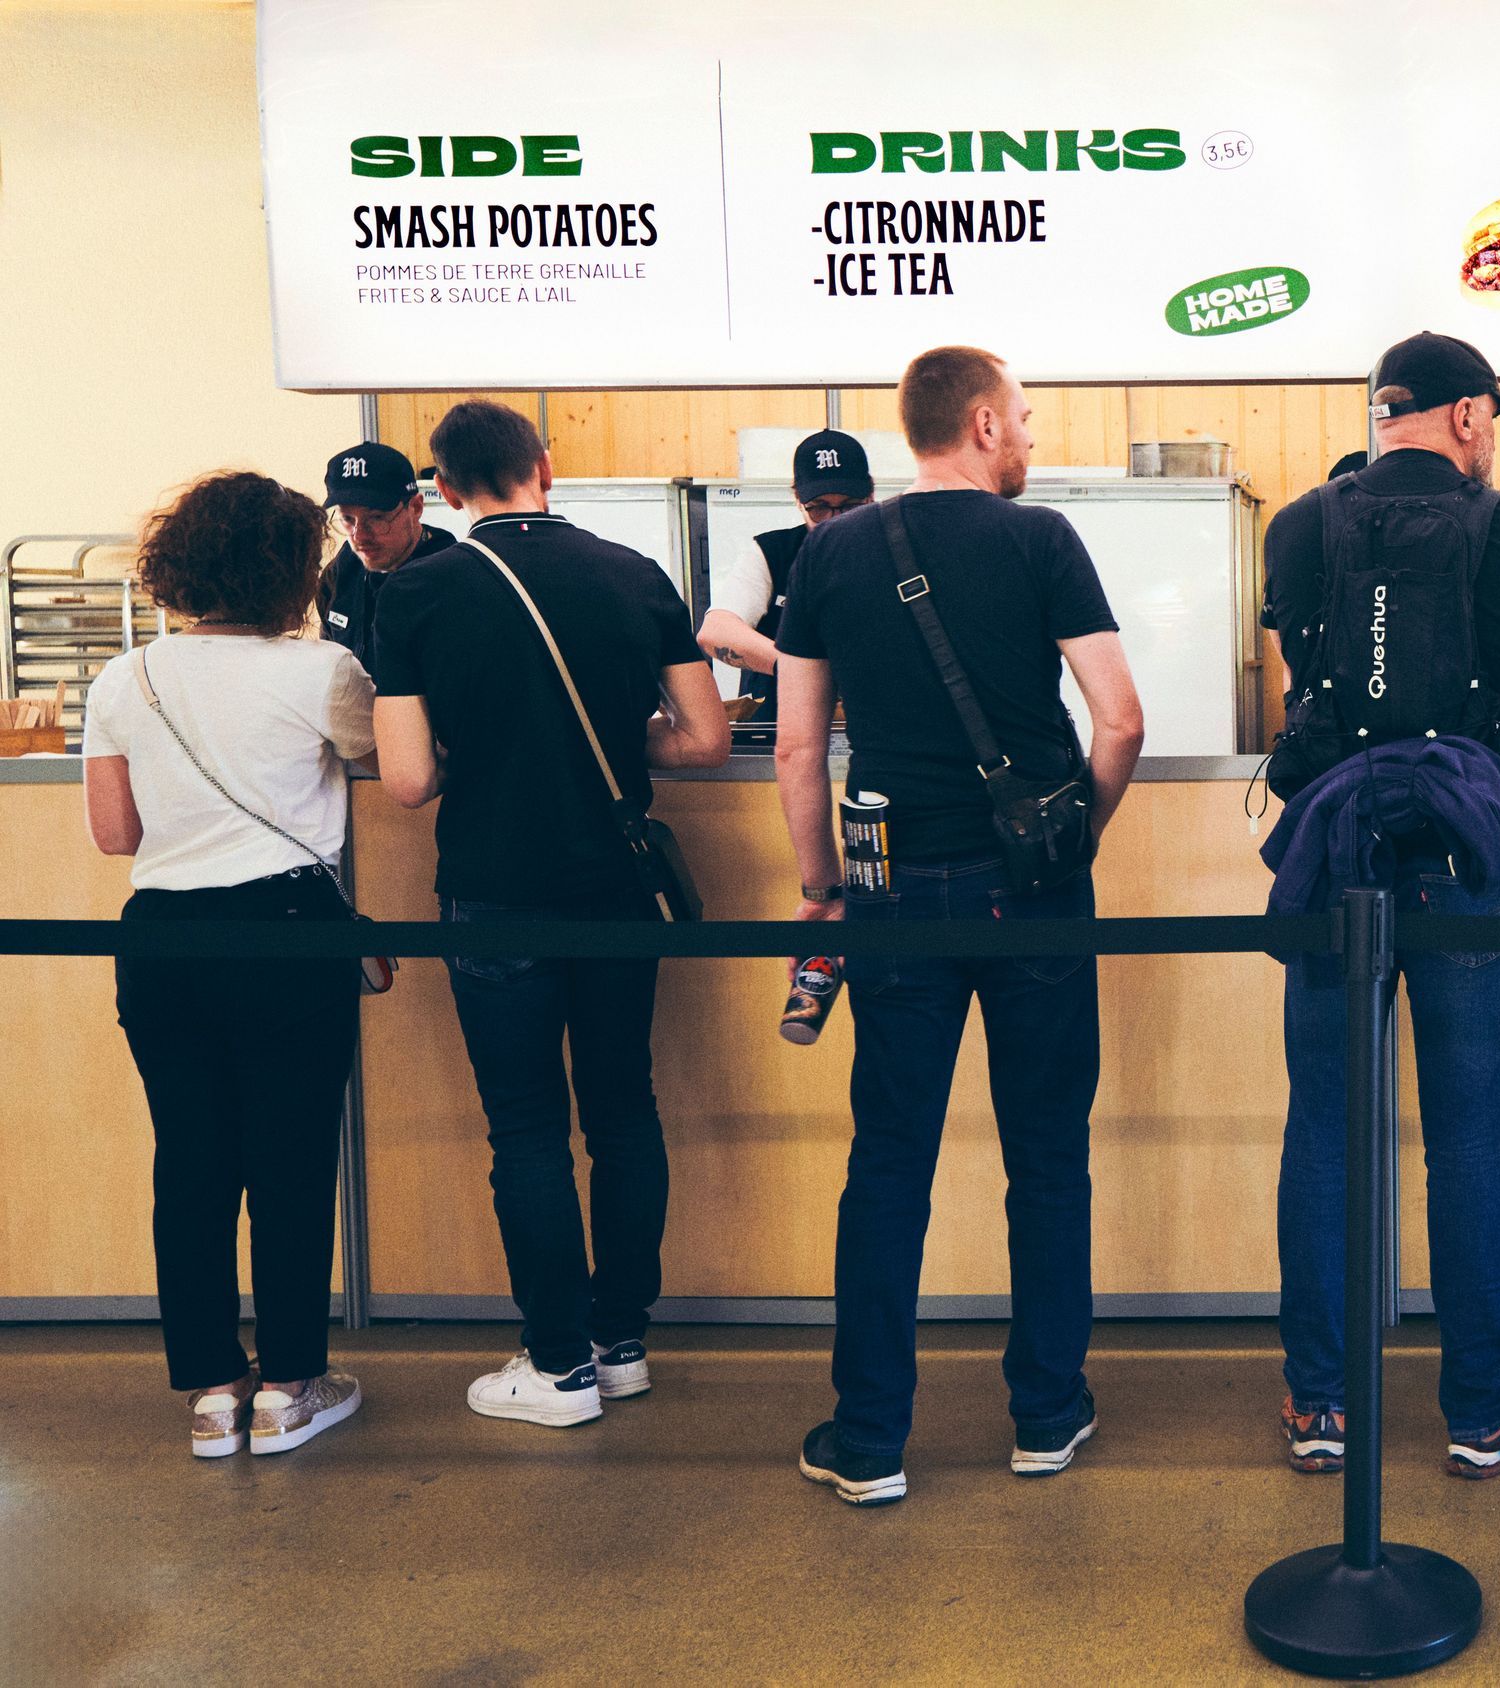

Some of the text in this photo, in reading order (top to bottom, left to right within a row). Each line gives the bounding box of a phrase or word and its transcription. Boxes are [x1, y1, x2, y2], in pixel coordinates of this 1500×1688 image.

[350, 135, 583, 178] SIDE
[810, 129, 1186, 173] DRINKS
[1207, 140, 1248, 162] 3,5€
[353, 201, 658, 249] SMASH POTATOES
[811, 199, 1046, 245] -CITRONNADE
[357, 263, 646, 280] POMMES DE TERRE GRENAILLE
[813, 252, 954, 296] -ICE TEA
[359, 288, 424, 303] FRITES
[431, 288, 442, 303] &
[449, 287, 511, 303] SAUCE
[535, 287, 576, 302] L'AIL
[1184, 274, 1289, 314] HOME
[1188, 292, 1294, 332] MADE
[342, 457, 369, 478] M
[815, 449, 842, 470] M
[1368, 584, 1387, 699] Quechua
